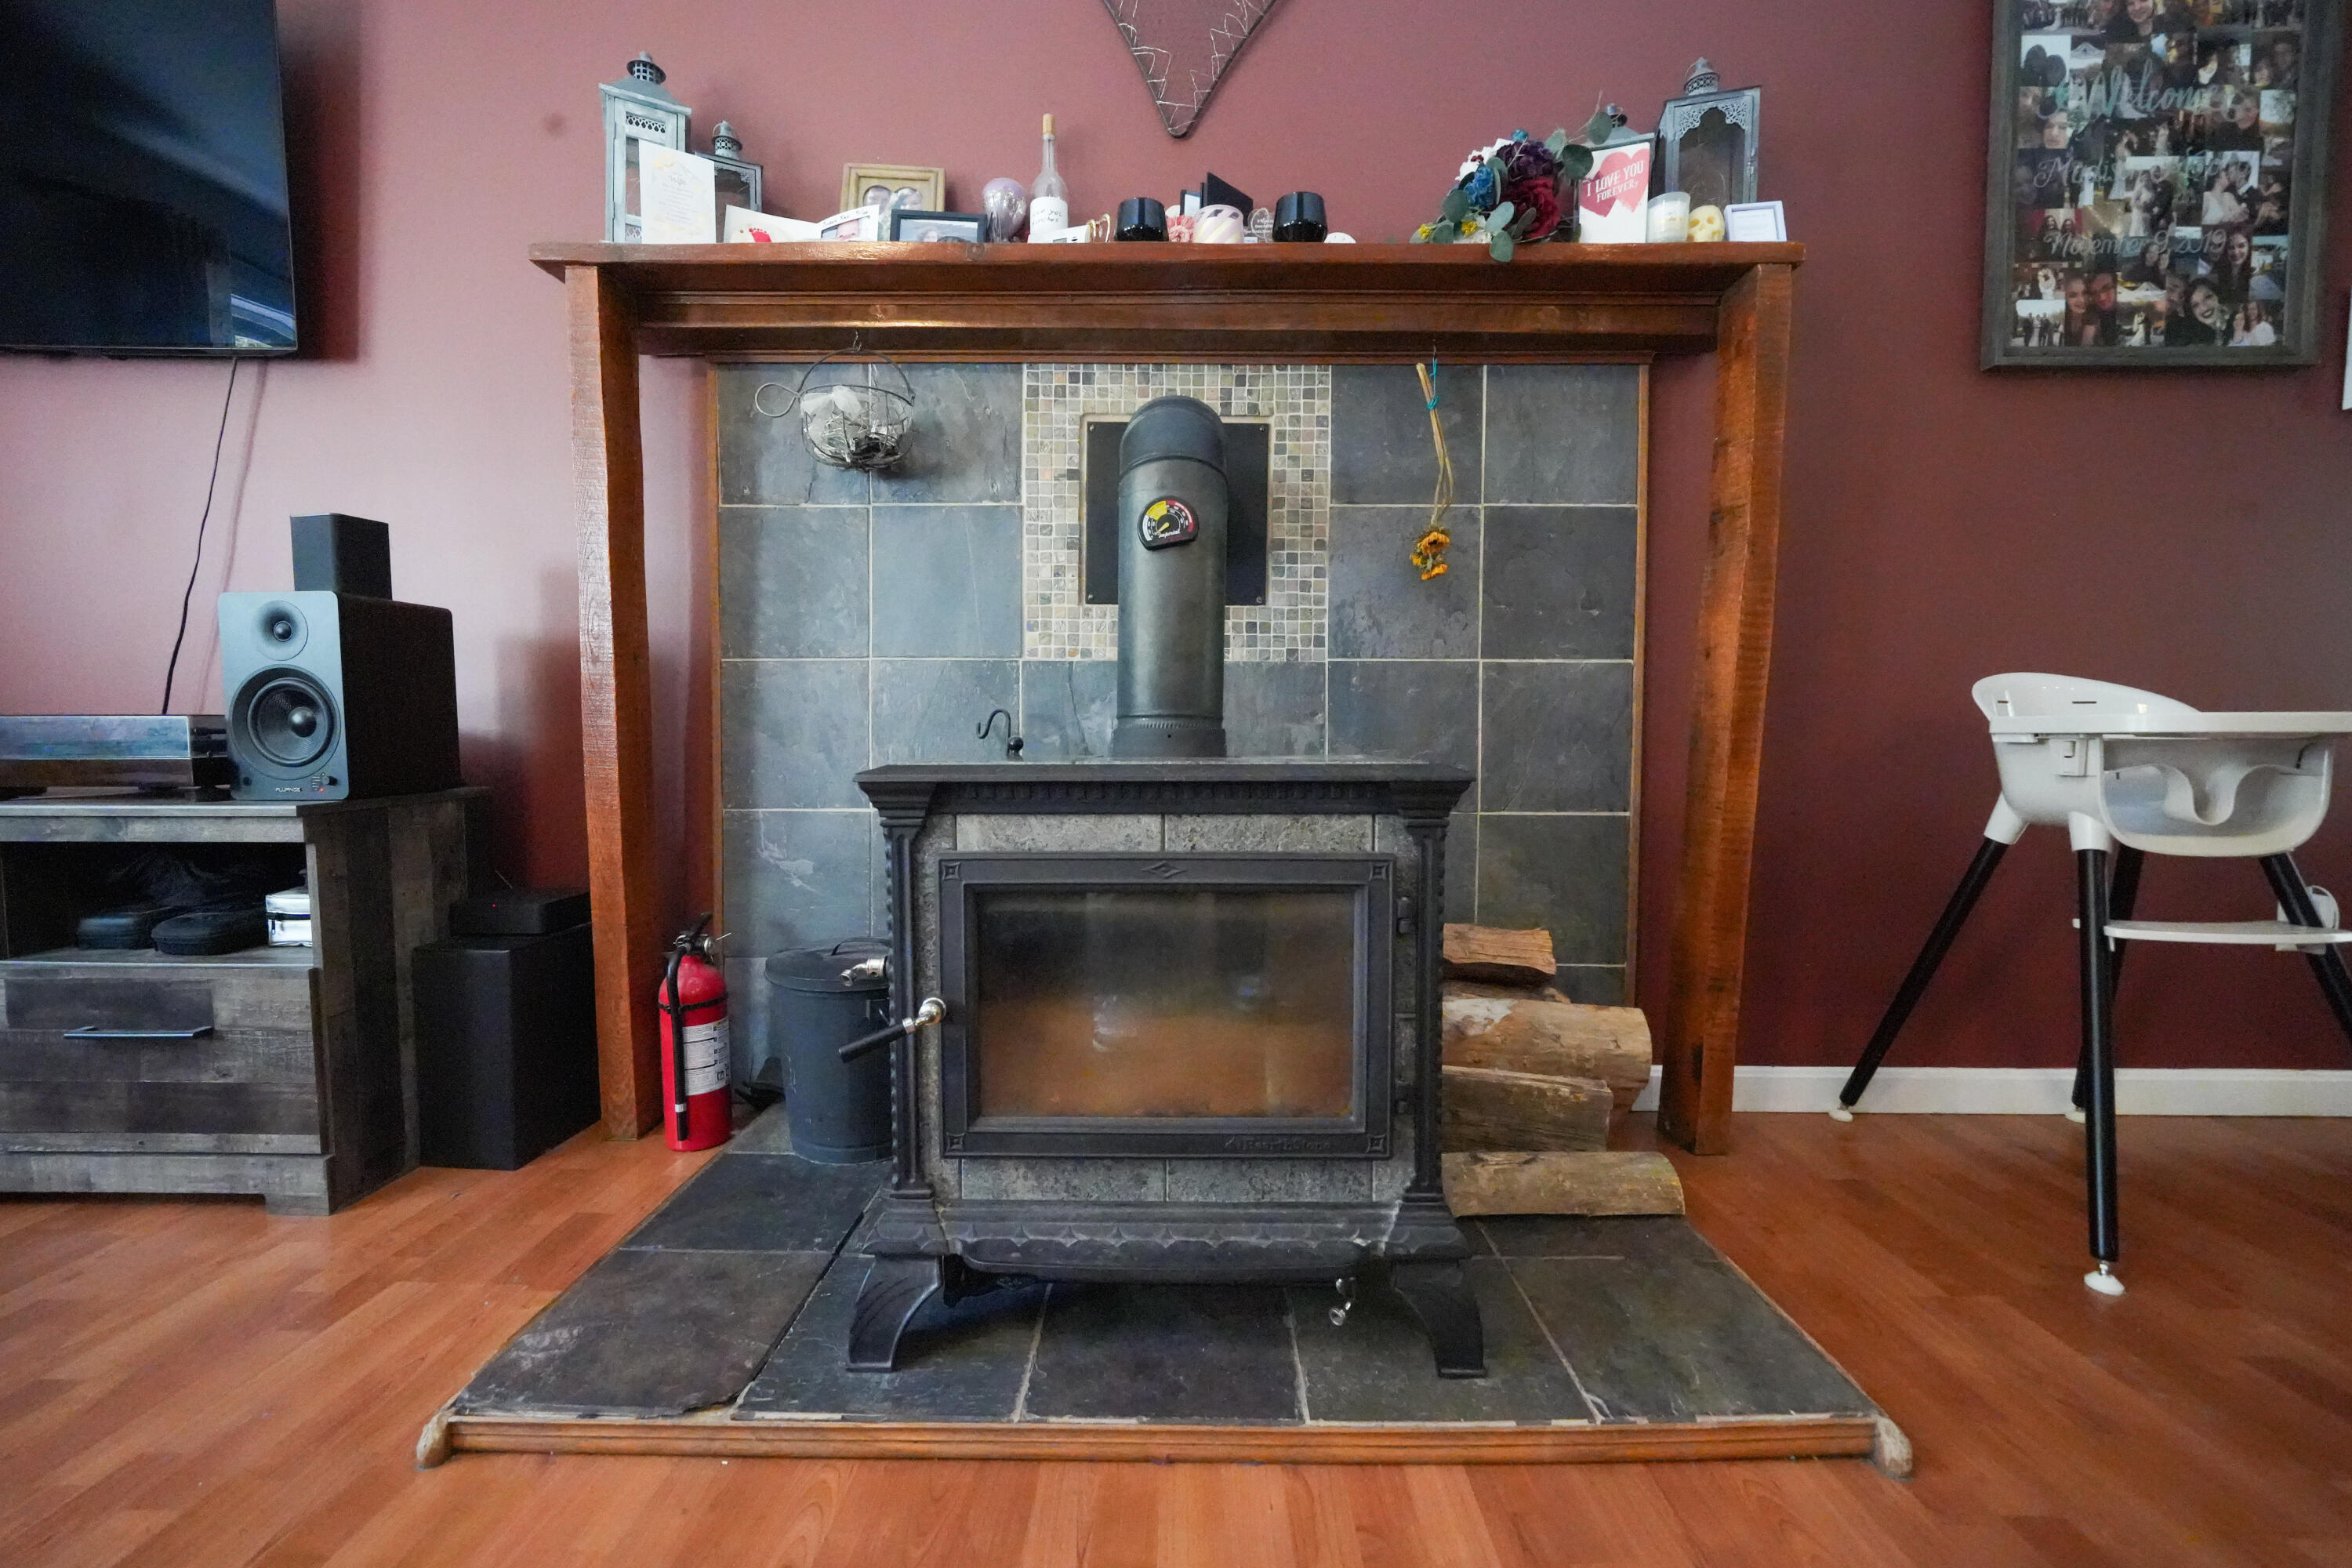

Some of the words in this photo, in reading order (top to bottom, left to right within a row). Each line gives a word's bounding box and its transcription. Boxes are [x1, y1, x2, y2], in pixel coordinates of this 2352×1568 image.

[1587, 183, 1592, 197] I
[1595, 169, 1621, 194] LOVE
[1623, 160, 1644, 180] YOU
[2042, 230, 2147, 258] November
[2174, 228, 2227, 255] 2019
